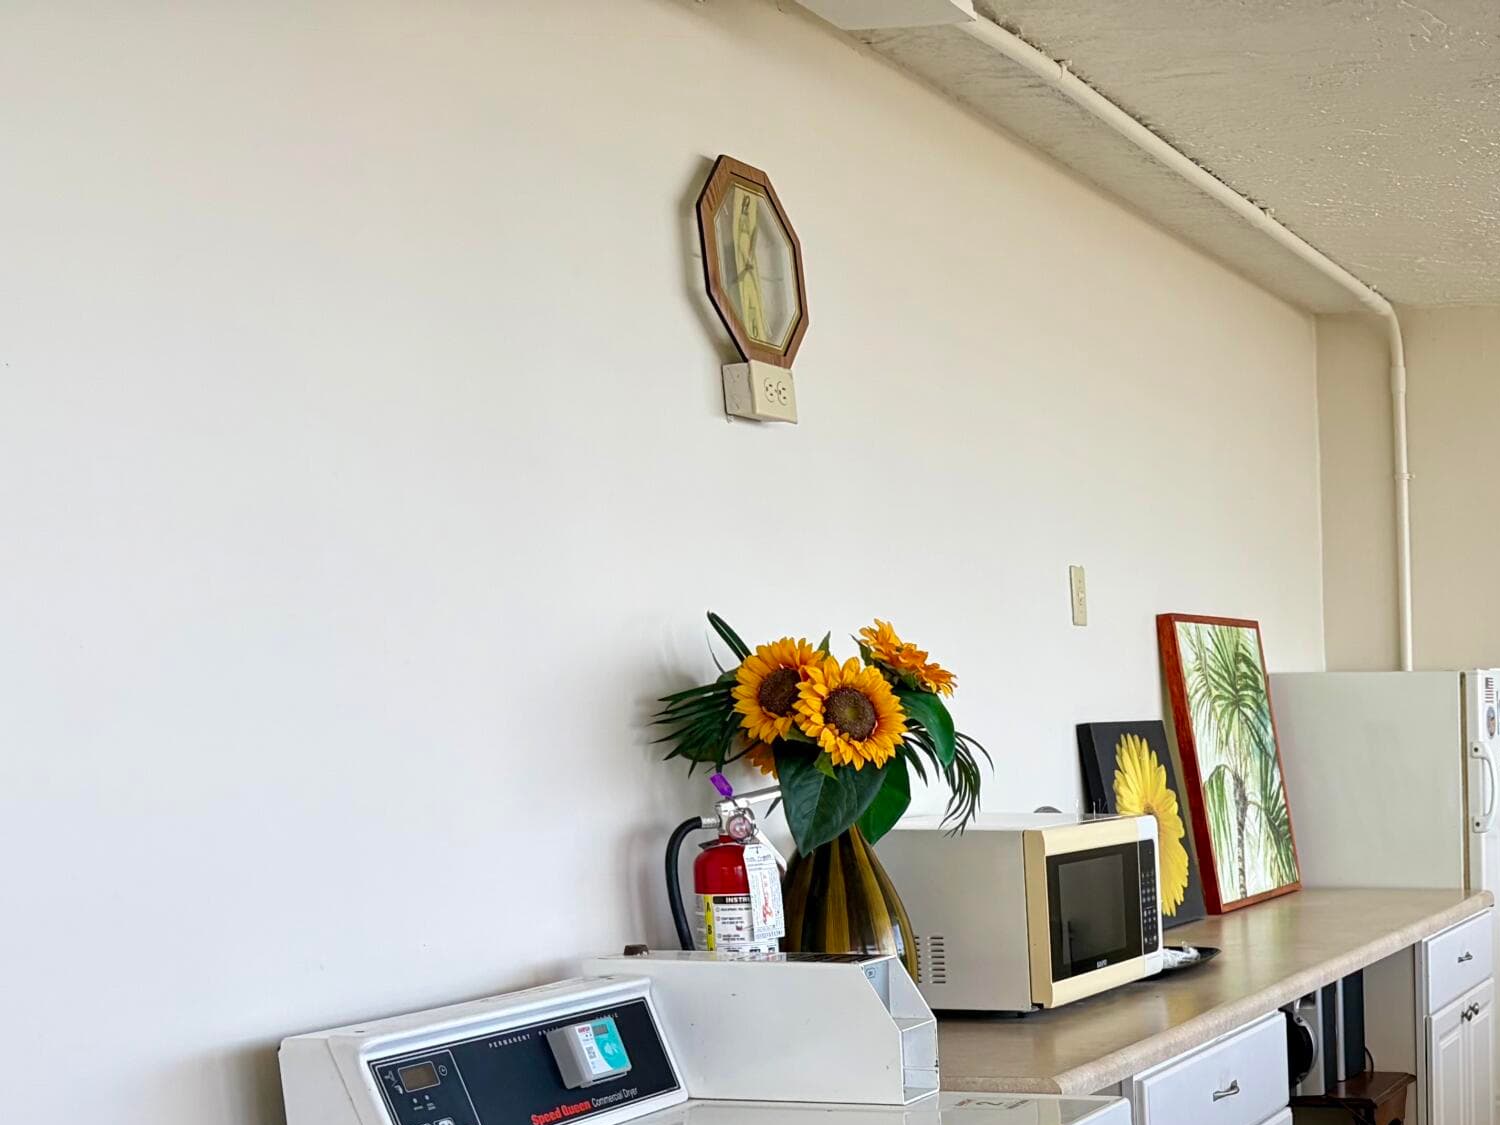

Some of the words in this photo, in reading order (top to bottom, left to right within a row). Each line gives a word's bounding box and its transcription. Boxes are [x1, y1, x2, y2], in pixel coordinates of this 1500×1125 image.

[560, 1101, 592, 1117] Queen
[591, 1090, 624, 1108] Commercial
[622, 1087, 639, 1099] Dryer
